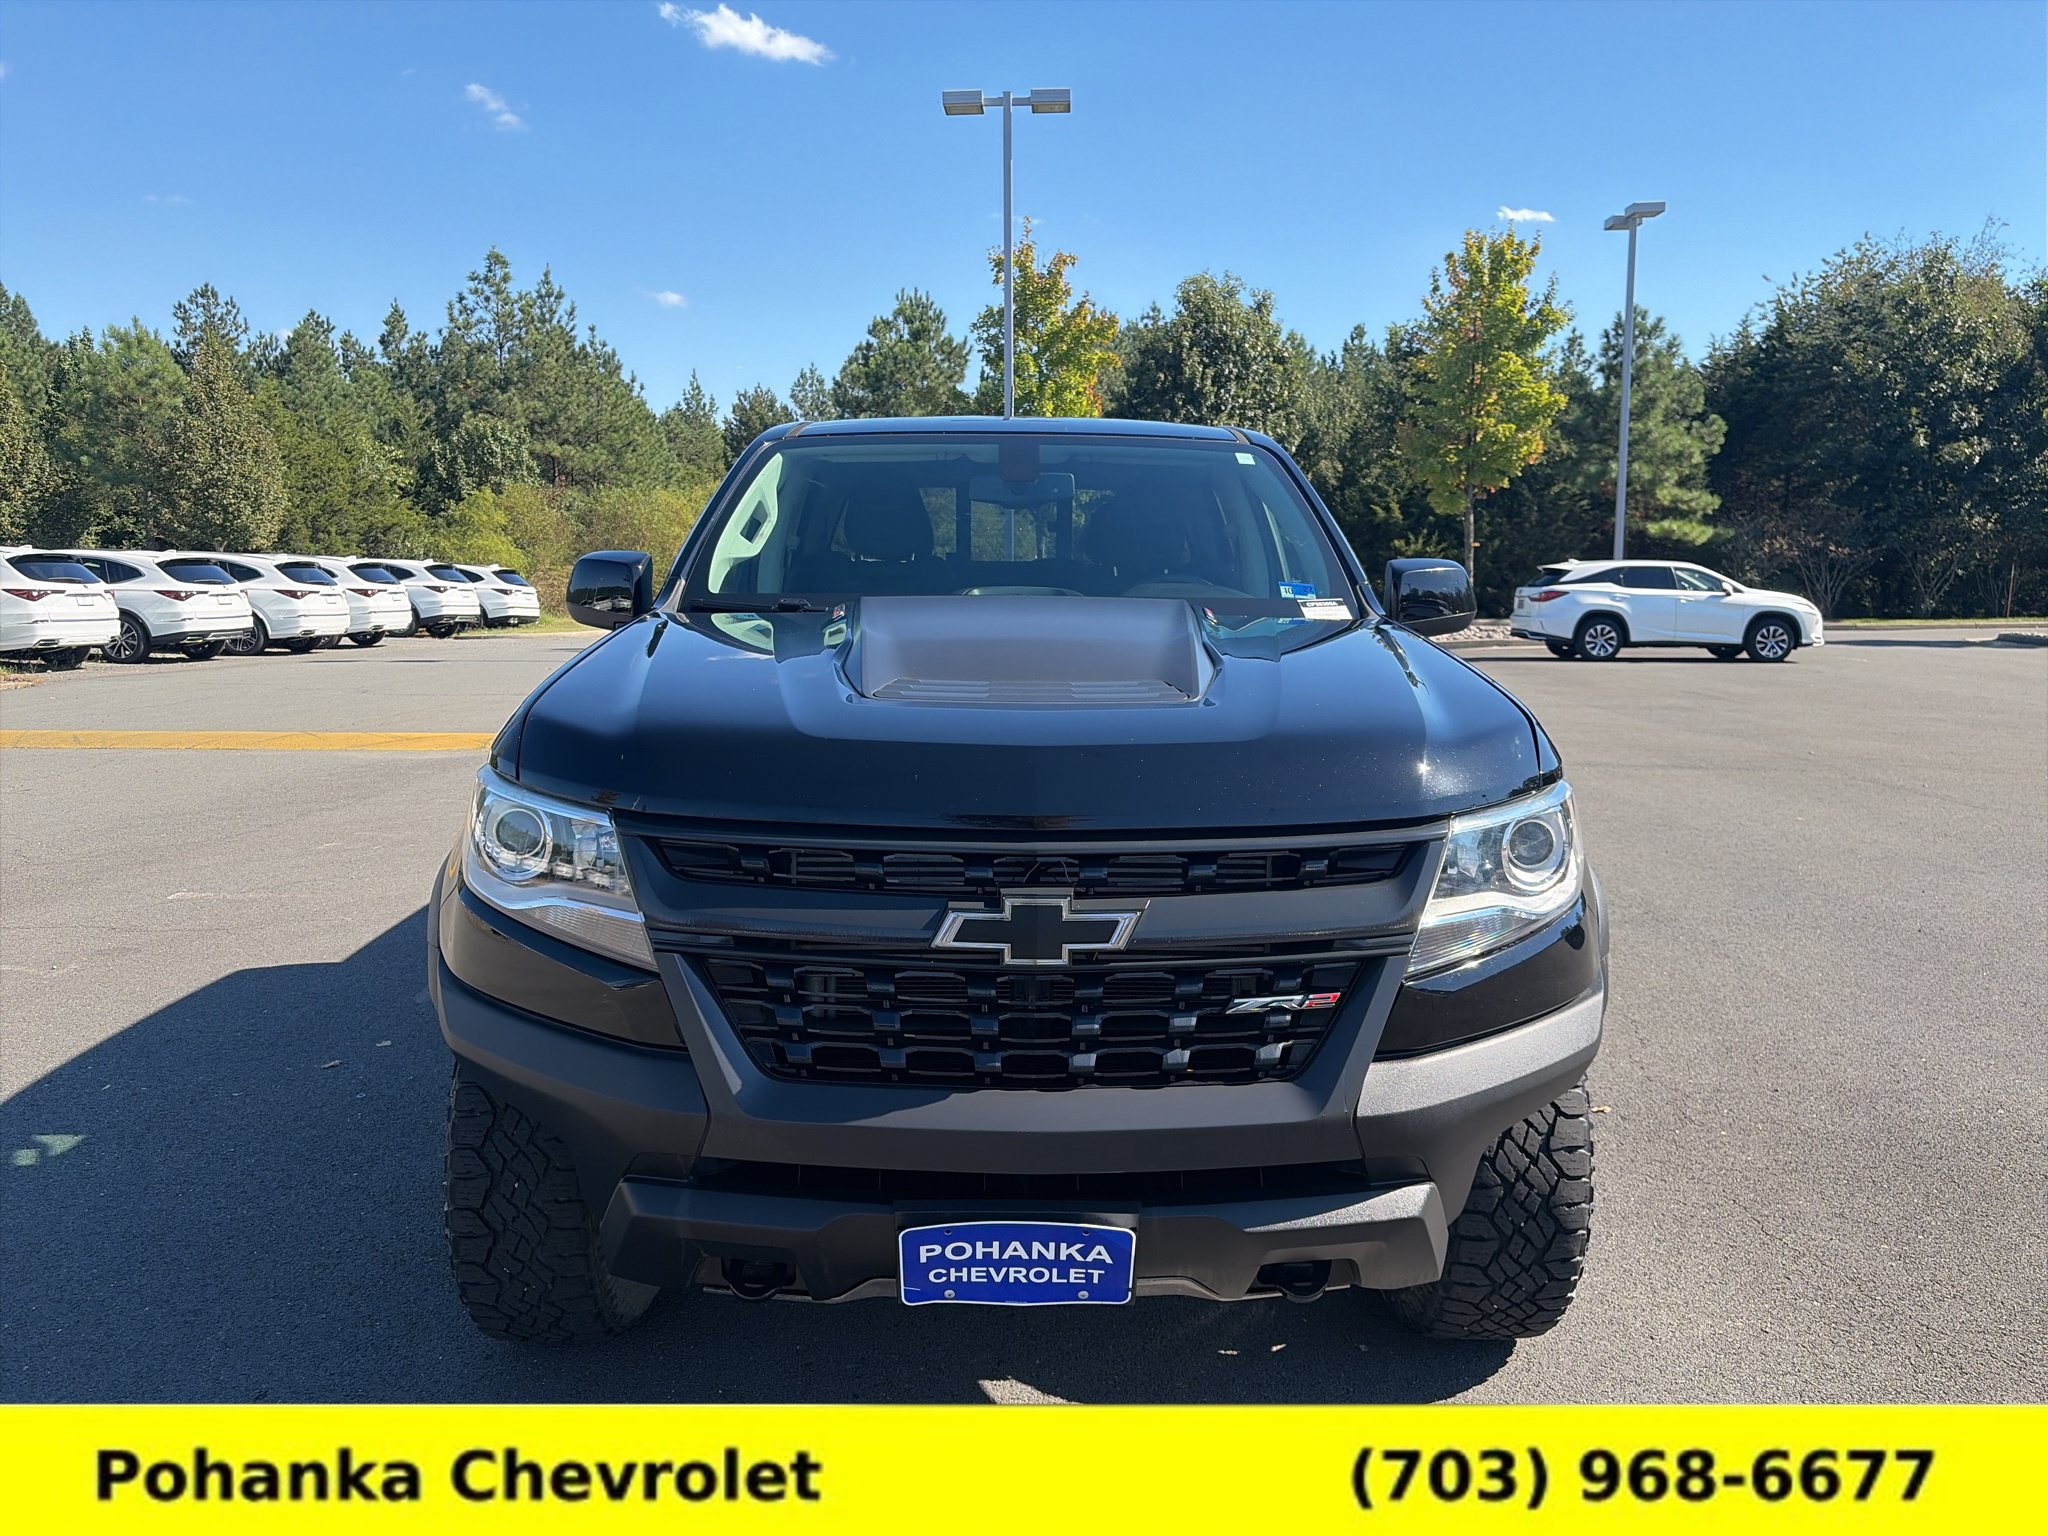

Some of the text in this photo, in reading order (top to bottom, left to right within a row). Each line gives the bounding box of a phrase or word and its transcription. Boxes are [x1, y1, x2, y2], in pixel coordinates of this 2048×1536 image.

[1225, 992, 1341, 1014] ZR2
[919, 1241, 1113, 1264] POHANKA
[928, 1266, 1105, 1284] CHEVROLET
